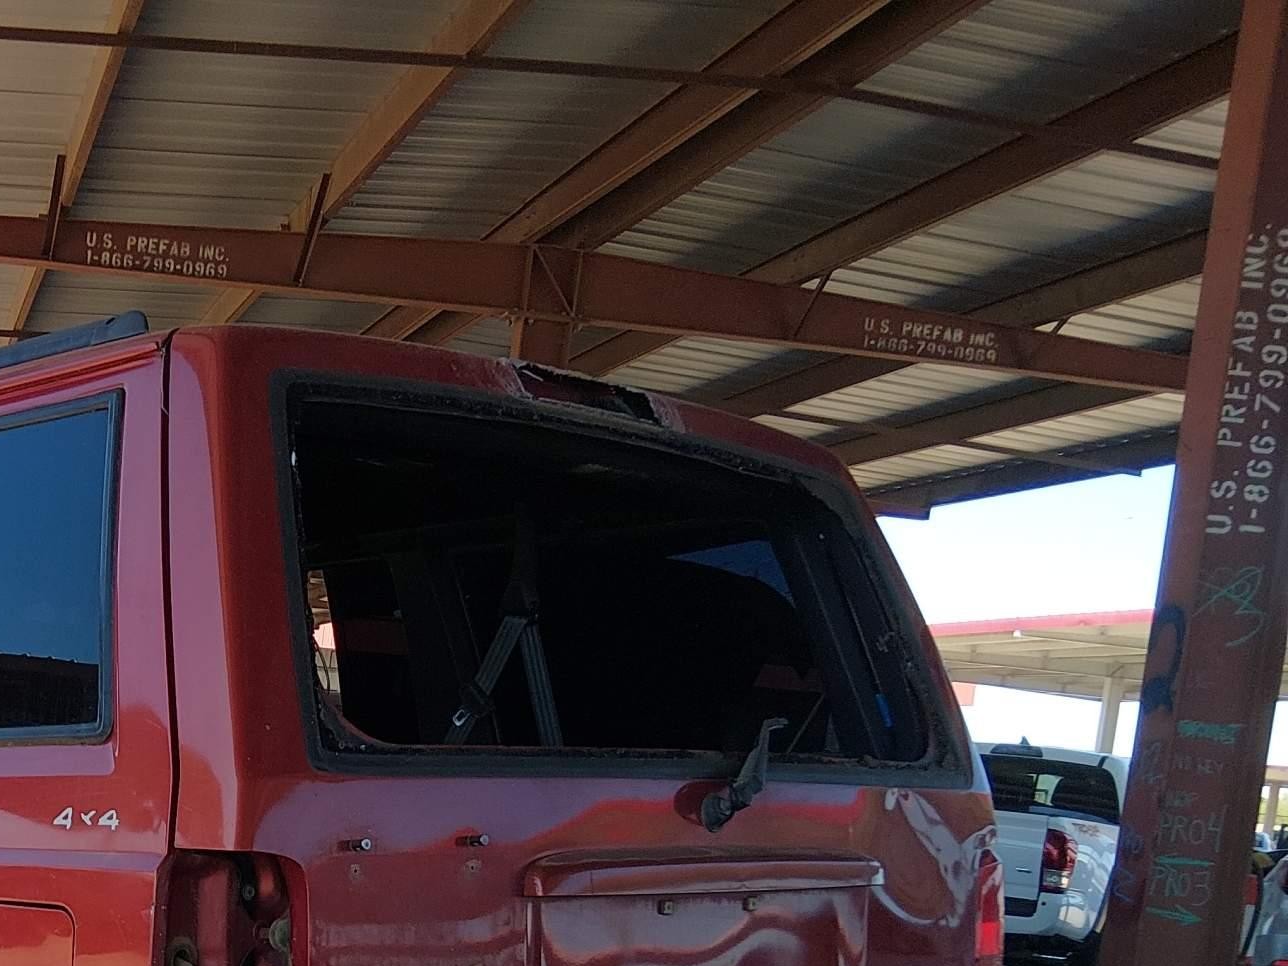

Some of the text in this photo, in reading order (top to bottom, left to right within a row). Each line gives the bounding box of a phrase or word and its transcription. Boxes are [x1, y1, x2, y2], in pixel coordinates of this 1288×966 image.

[126, 235, 191, 257] PREFAB
[199, 244, 230, 262] INC.
[1240, 223, 1273, 289] INC.
[85, 249, 228, 278] 1-866-799-0969
[902, 321, 964, 343] PREFAB
[969, 332, 1000, 348] INC.
[1215, 309, 1259, 448] PREFAB
[1205, 469, 1241, 534] U.S.
[53, 807, 120, 830] 4x4
